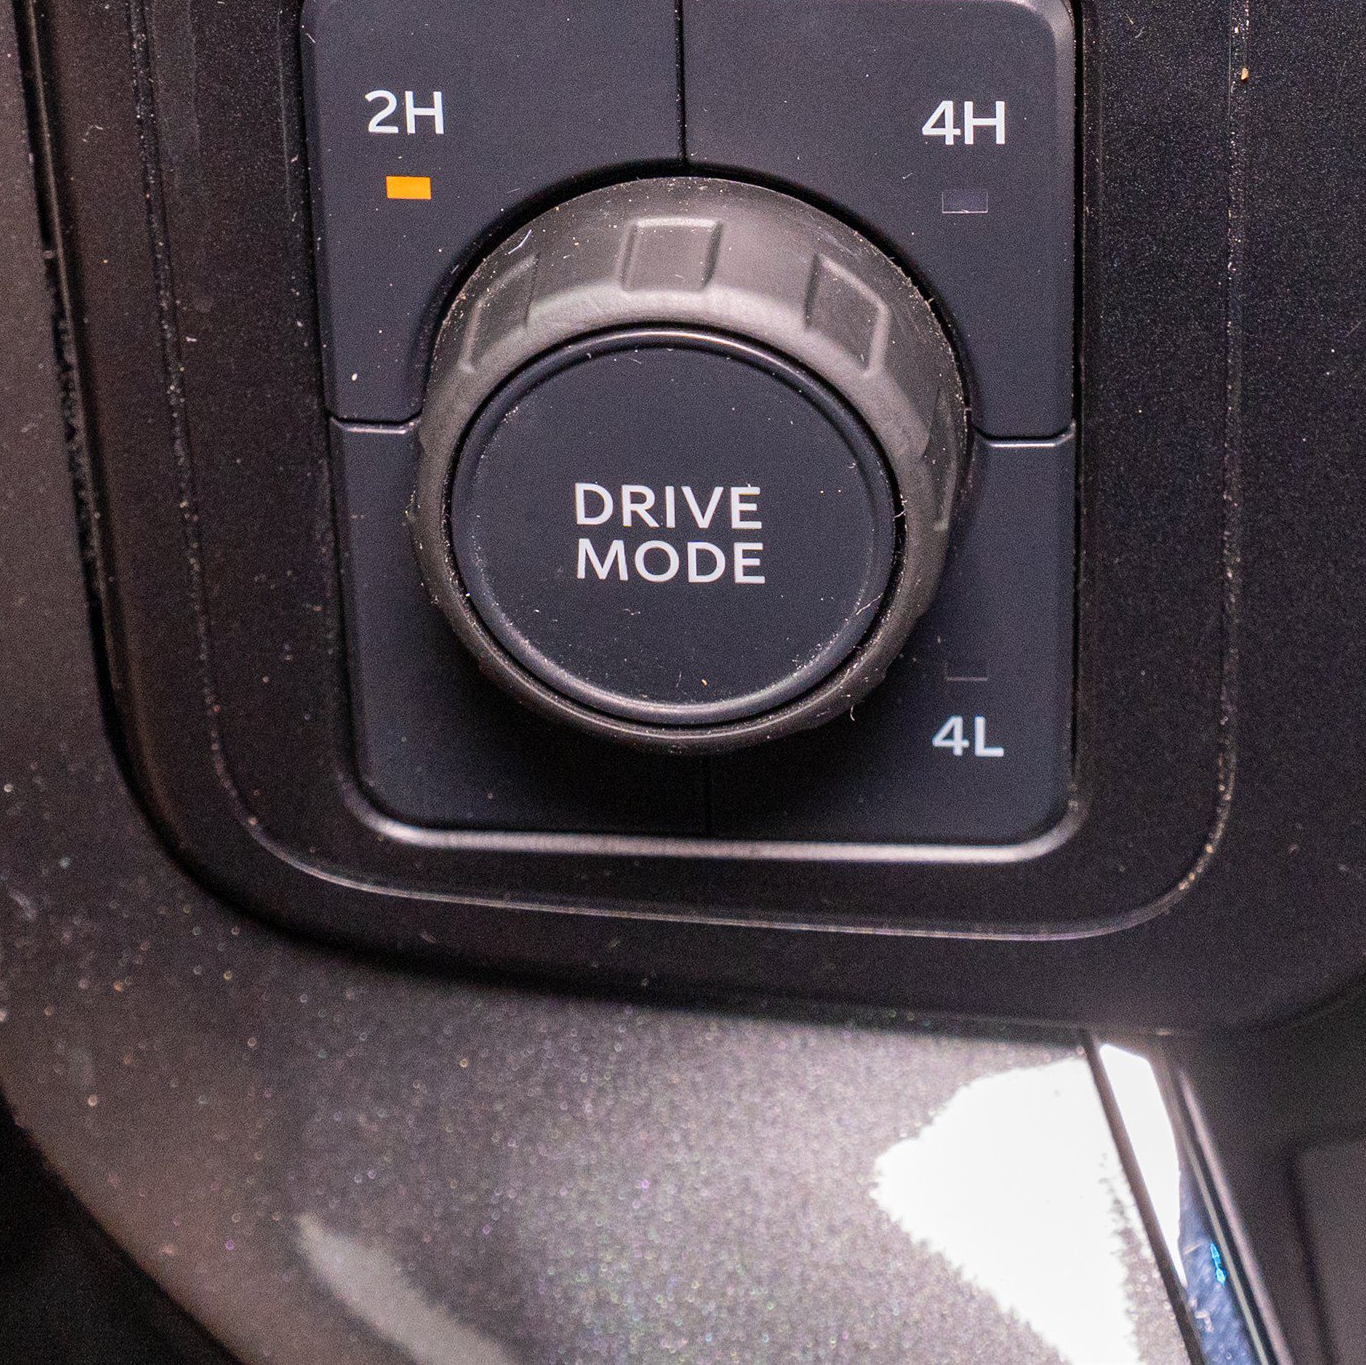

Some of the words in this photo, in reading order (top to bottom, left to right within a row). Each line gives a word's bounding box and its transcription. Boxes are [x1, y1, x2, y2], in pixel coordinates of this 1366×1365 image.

[364, 89, 445, 135] 2H
[921, 100, 1007, 146] 4H
[575, 483, 763, 530] DRIVE
[576, 538, 767, 584] MODE
[932, 715, 1005, 757] 4L
